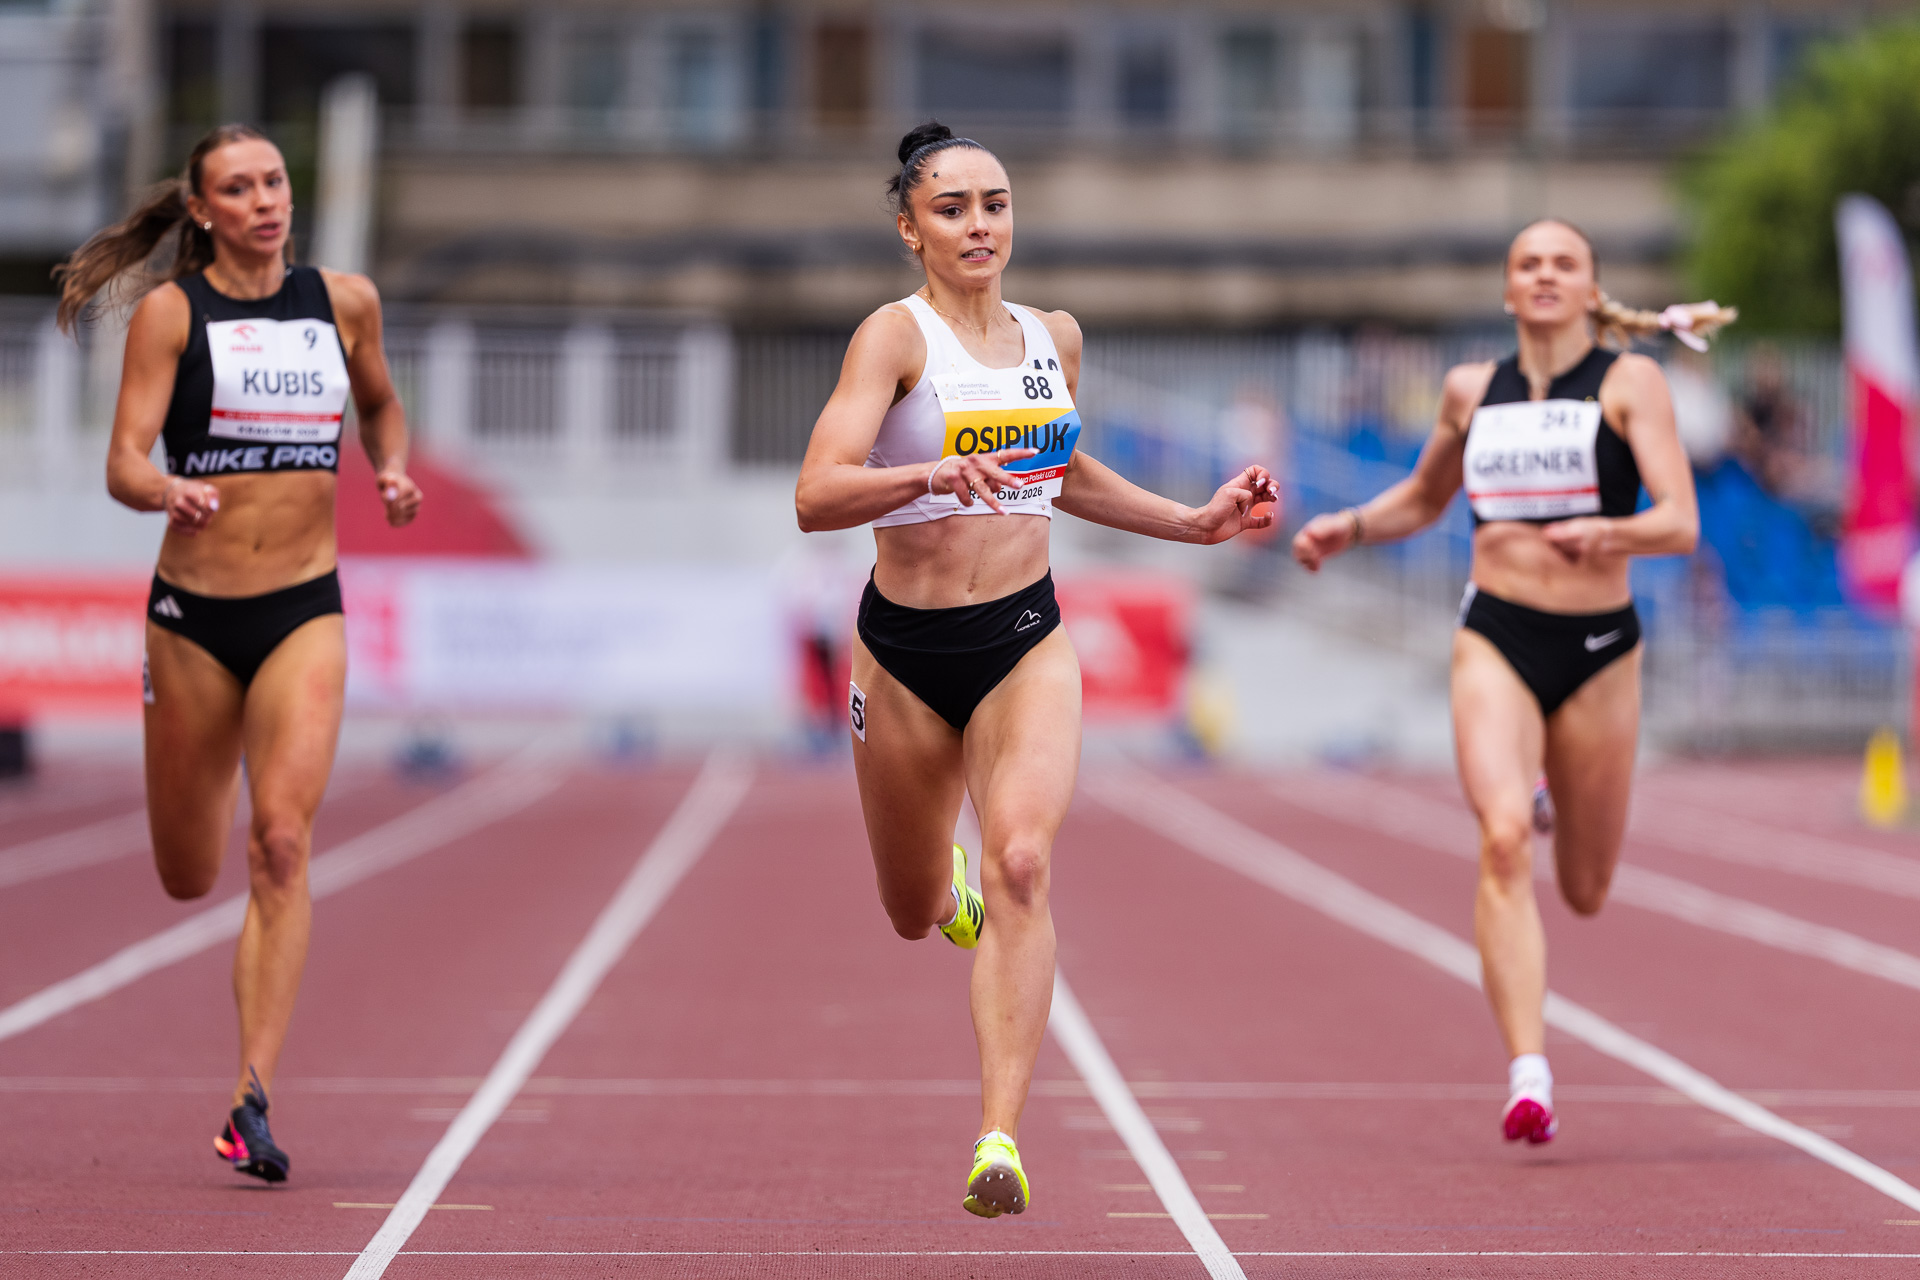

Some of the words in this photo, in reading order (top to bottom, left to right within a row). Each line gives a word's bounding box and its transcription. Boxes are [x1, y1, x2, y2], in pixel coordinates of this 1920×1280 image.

[303, 328, 318, 351] 9
[242, 368, 324, 396] KUBIS
[1022, 375, 1053, 400] 88
[954, 423, 1070, 456] OSIPIUK
[184, 447, 269, 475] NIKE
[270, 445, 337, 468] PRO
[1472, 450, 1584, 476] GREINER
[1029, 471, 1045, 482] Polski
[1022, 485, 1043, 500] 2026
[851, 692, 864, 732] 5
